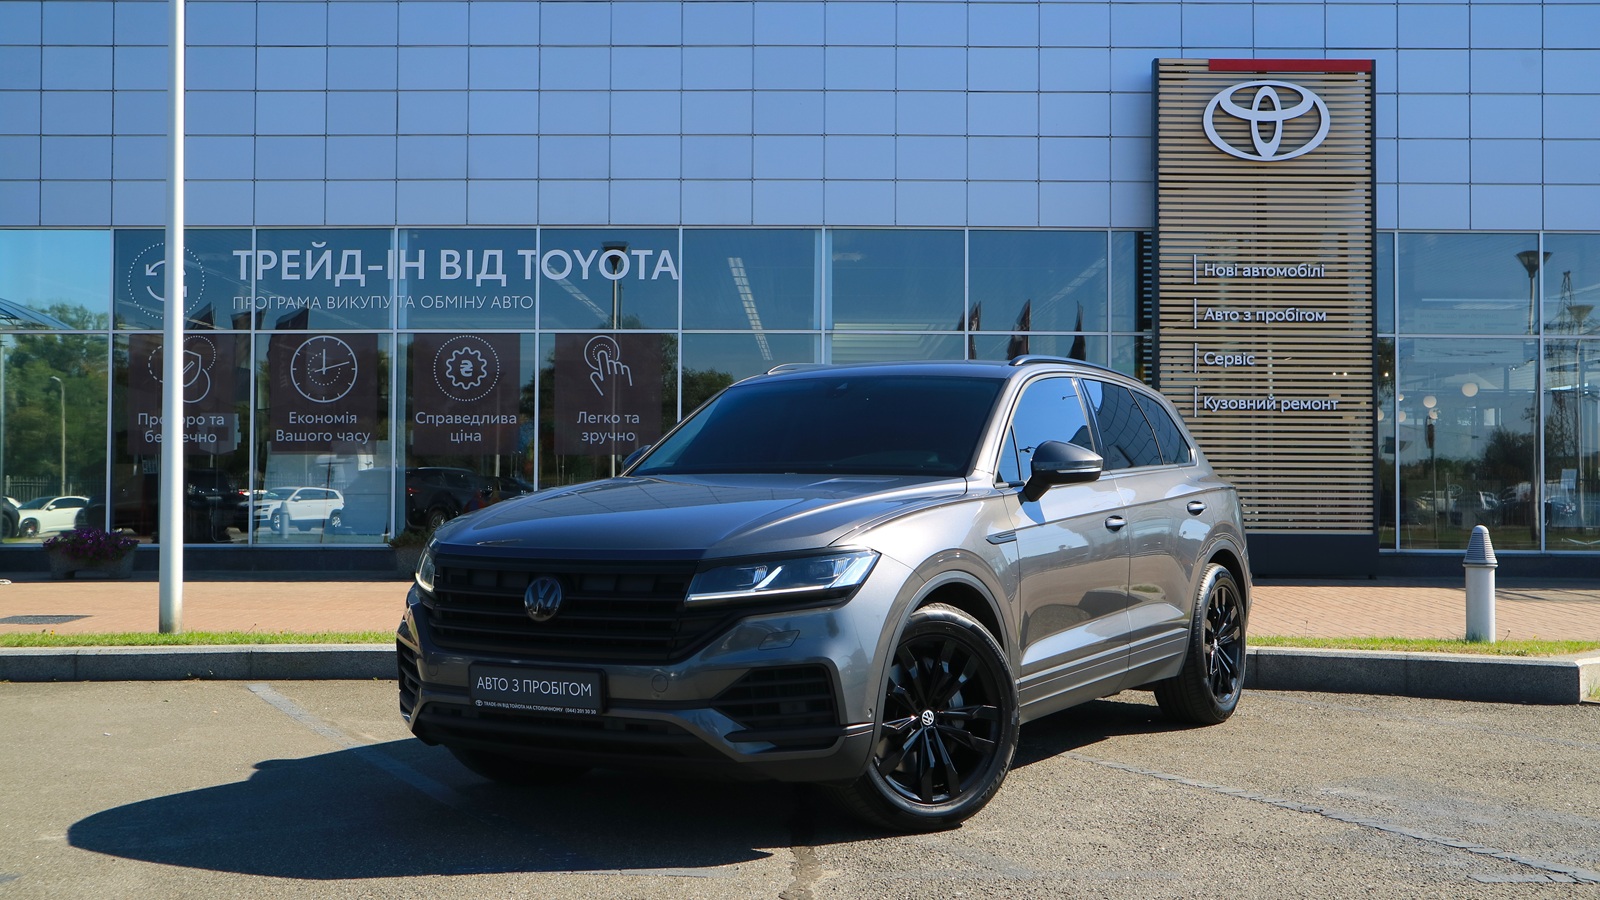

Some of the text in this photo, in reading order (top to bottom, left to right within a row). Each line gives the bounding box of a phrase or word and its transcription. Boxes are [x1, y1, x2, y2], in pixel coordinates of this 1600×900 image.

[232, 241, 679, 287] ТРЕЙД-ІН ВІД TOYOTA
[1204, 263, 1325, 277] Нові автомобілі
[233, 295, 534, 309] ПРОГРАМА ВИКУПУ ТА ОБМІНУ АВТО
[1204, 307, 1327, 324] Авто з пробігом
[1203, 352, 1255, 368] Сервіс
[1203, 395, 1339, 413] Кузовний ремонт
[209, 415, 225, 425] та
[289, 411, 357, 424] Економія
[415, 411, 517, 427] Справедлива
[577, 411, 640, 424] Легко та
[276, 429, 371, 445] Вашого часу
[450, 429, 482, 444] ціна
[581, 431, 636, 445] зручно
[477, 676, 508, 691] АВТО
[523, 679, 592, 697] ПРОБІГОМ
